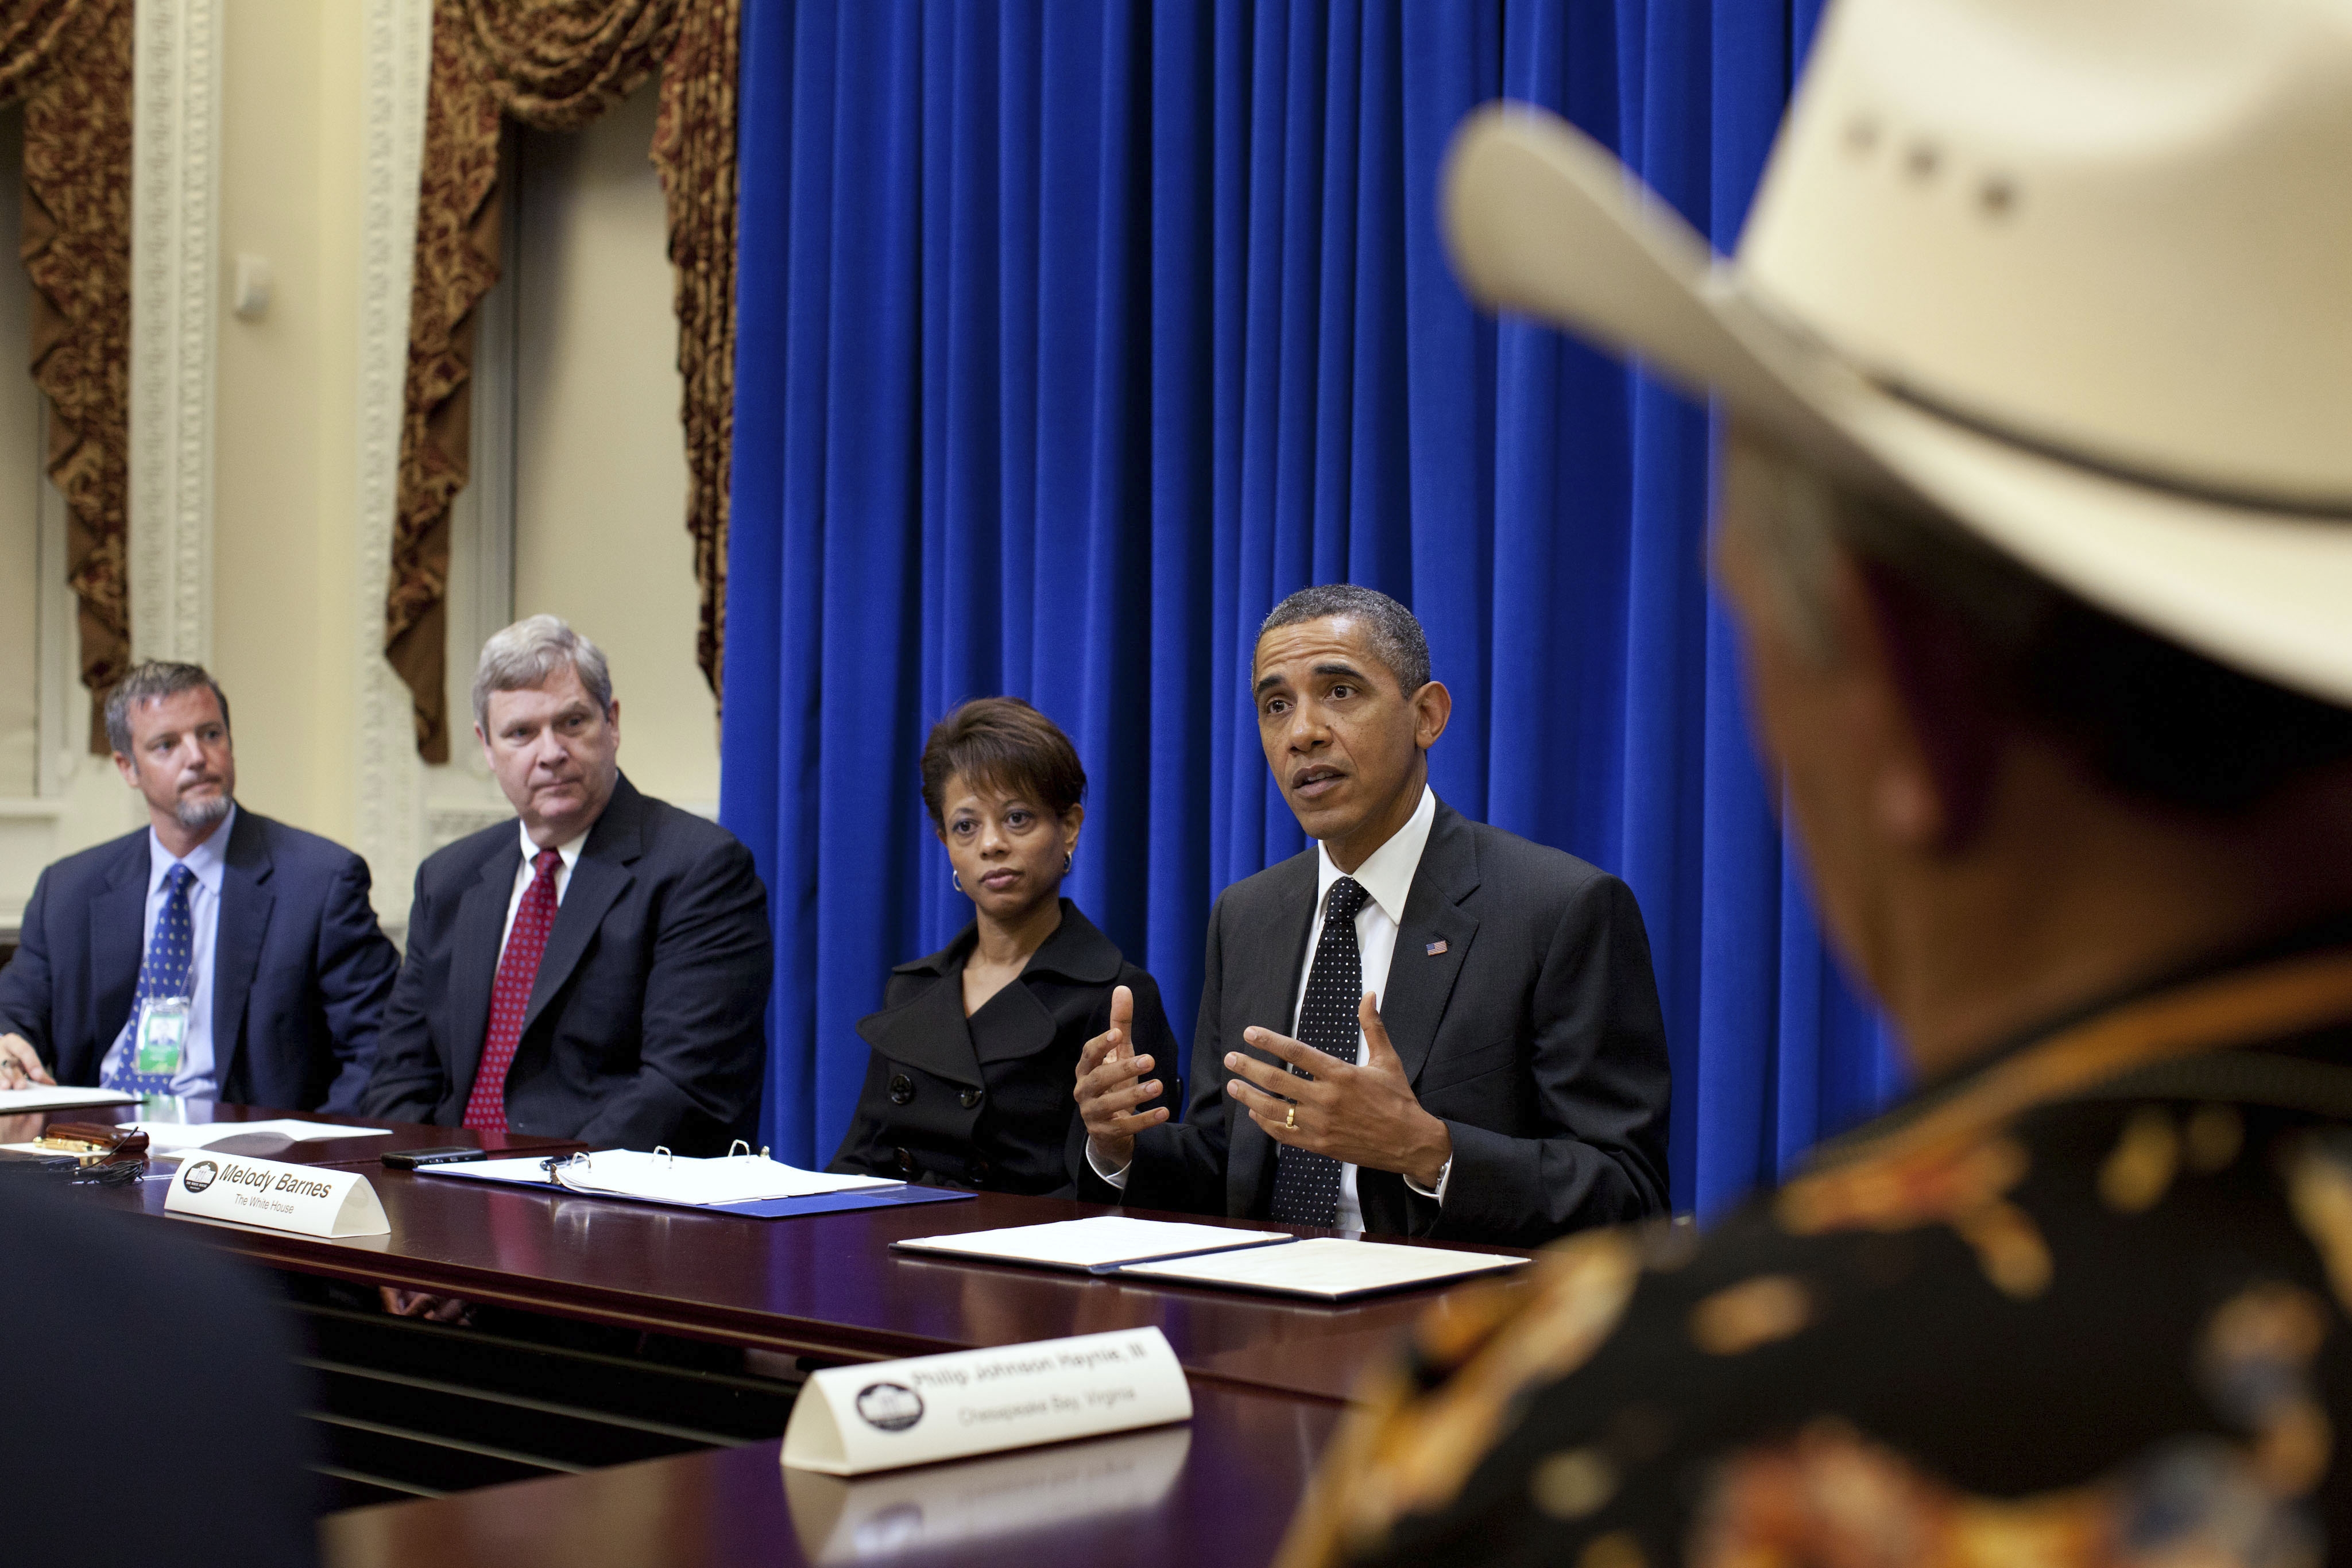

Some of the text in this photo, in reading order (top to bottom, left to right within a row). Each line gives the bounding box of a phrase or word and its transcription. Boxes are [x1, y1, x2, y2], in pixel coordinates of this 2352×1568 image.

[219, 1164, 332, 1198] Melody Barnes
[235, 1194, 294, 1214] The White House
[976, 1357, 1055, 1381] Johnson
